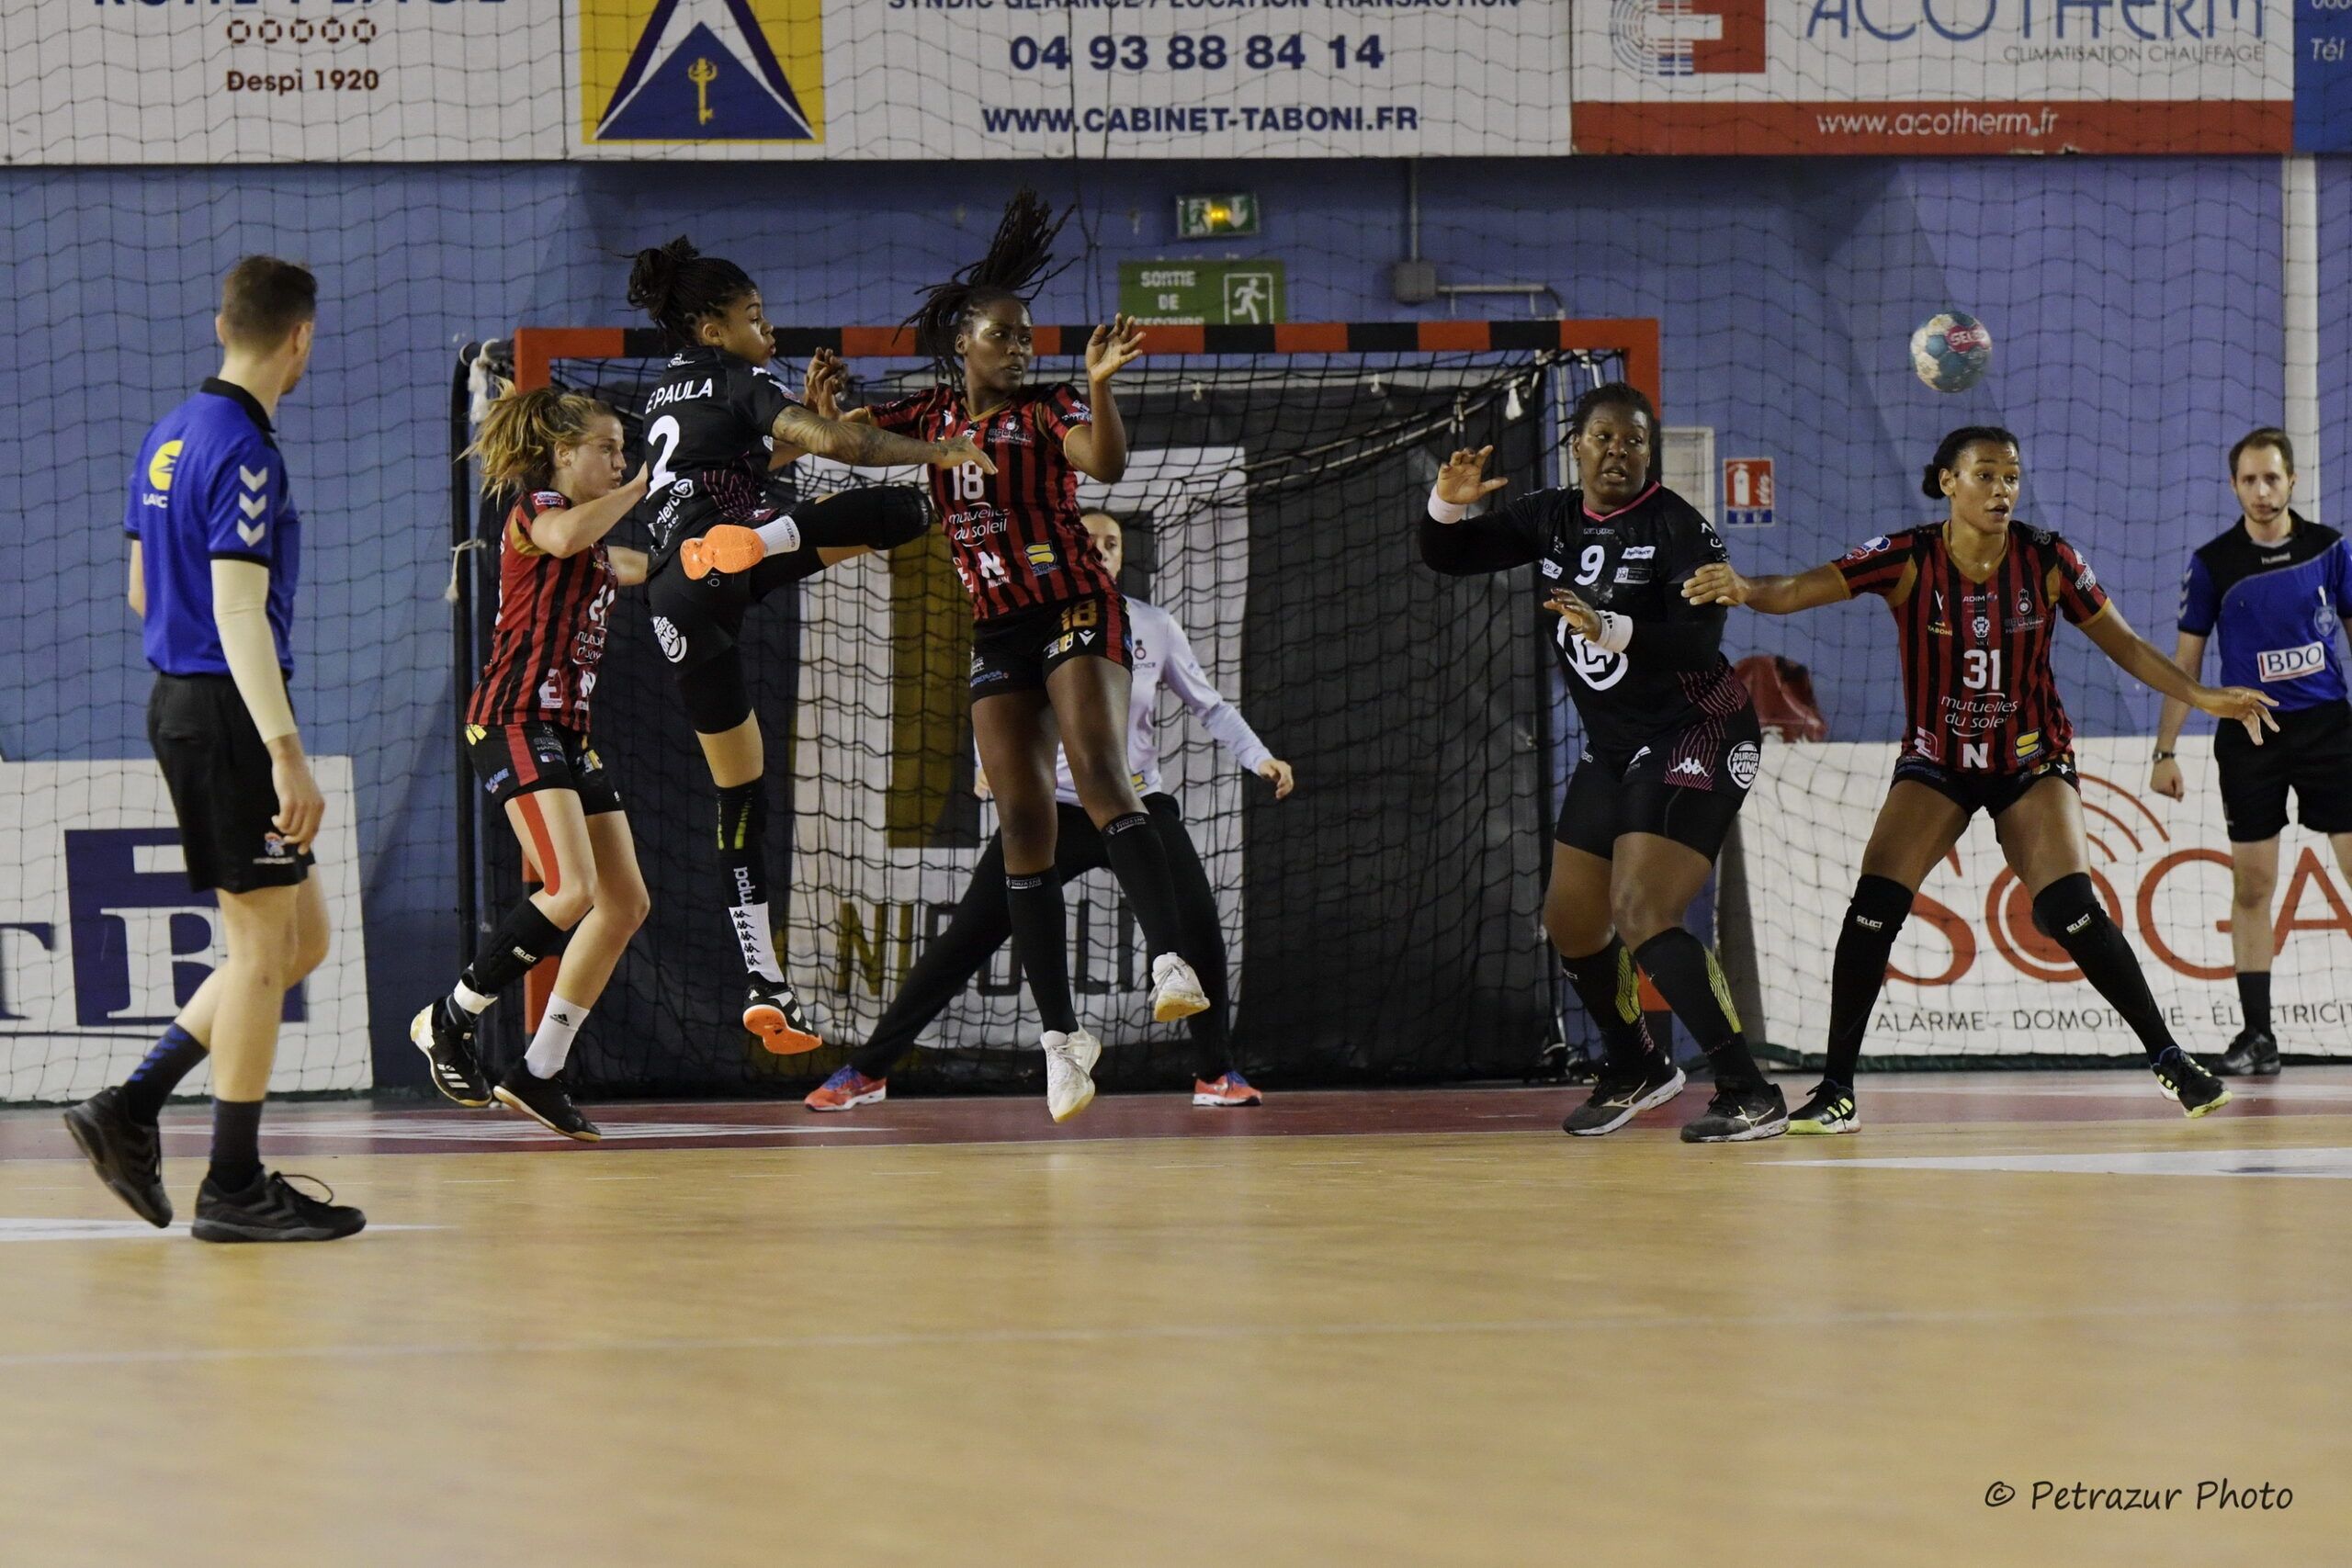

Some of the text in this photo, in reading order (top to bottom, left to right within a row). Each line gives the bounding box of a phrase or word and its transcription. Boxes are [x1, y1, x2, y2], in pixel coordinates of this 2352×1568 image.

[1010, 34, 1385, 70] 04 93 88 84 14
[2003, 44, 2265, 62] CLIMATISATION CHAUFFAGE
[315, 69, 379, 91] 1920
[982, 107, 1418, 133] WWW.CABINET-TABONI.FR
[1816, 107, 2060, 136] www.acotherm.fr
[1140, 270, 1196, 288] SORTIE
[1158, 293, 1181, 310] DE
[645, 414, 681, 499] 2
[953, 461, 985, 501] 18
[954, 518, 1008, 541] du soleil
[978, 551, 1005, 579] N
[1574, 544, 1606, 586] 9
[1962, 649, 2001, 690] 31
[2267, 646, 2323, 674] BDO
[1940, 695, 2019, 713] mutuelles
[1944, 712, 1967, 727] du
[1962, 742, 1989, 769] N
[1875, 1010, 1986, 1032] ALARME
[2013, 1007, 2185, 1031] DOMOTIE
